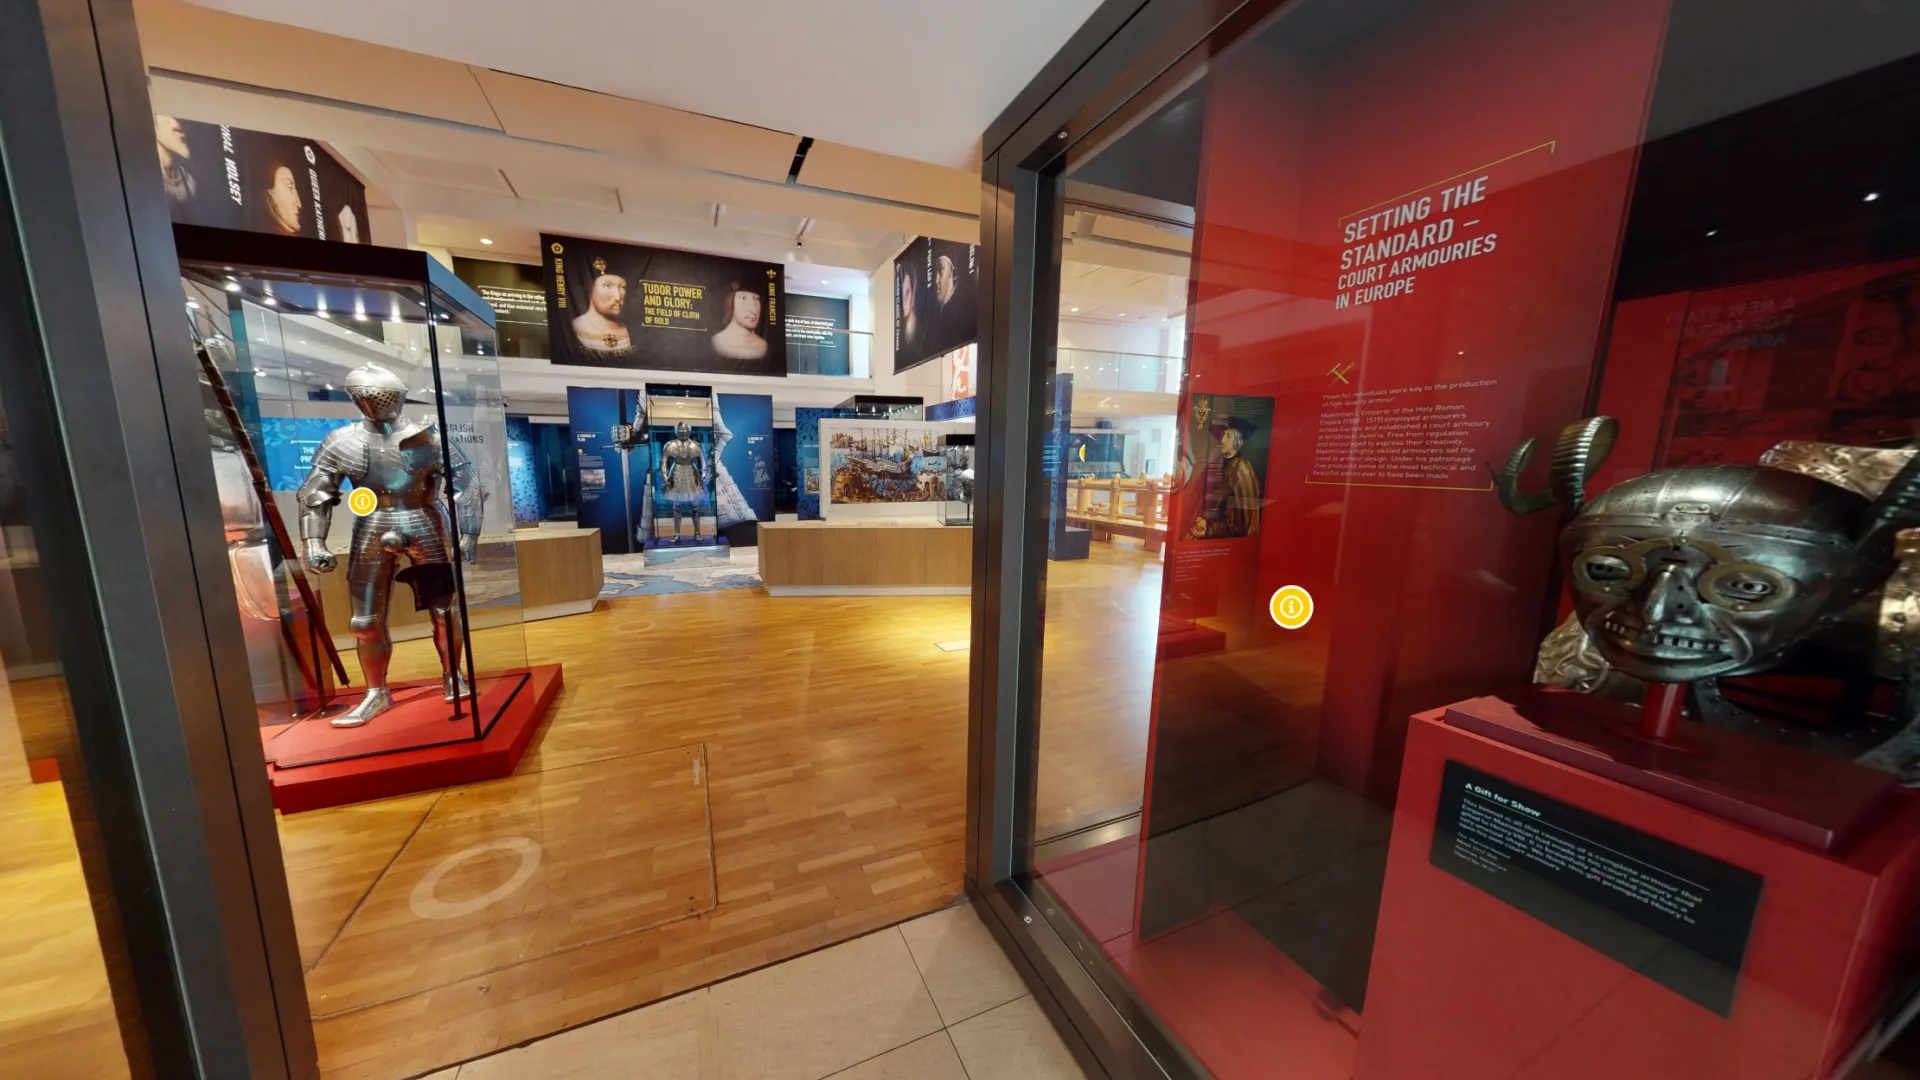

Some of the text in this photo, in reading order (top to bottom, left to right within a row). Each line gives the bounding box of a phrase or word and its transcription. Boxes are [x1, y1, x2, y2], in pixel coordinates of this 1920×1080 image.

[220, 124, 242, 206] INAL WOLSEY
[308, 168, 320, 201] QUEEN
[1344, 175, 1489, 244] SETTING THE
[1341, 218, 1454, 270] STANDARD
[554, 258, 564, 274] KING
[1338, 233, 1498, 290] COURT ARMOURIES
[556, 274, 566, 296] HENRY
[642, 283, 703, 299] TUDOR POWER
[768, 282, 776, 297] KING
[1335, 276, 1416, 310] IN EUROPE
[644, 295, 693, 309] AND GLORY:
[644, 307, 700, 319] THE FIELD OF CLOTH
[645, 316, 670, 325] OF GOLD
[1449, 379, 1498, 390] production
[1361, 409, 1391, 417] Emperor
[1415, 405, 1433, 414] Holy
[1435, 404, 1465, 412] Roman
[1384, 415, 1420, 424] employed
[1422, 412, 1467, 421] armourers
[446, 423, 474, 433] GLISH
[1378, 422, 1421, 431] established
[1452, 420, 1491, 429] armoury
[1426, 429, 1469, 438] regulation
[1429, 456, 1472, 464] patronage
[1474, 786, 1492, 798] Gift
[1494, 793, 1510, 804] for
[1510, 800, 1541, 817] Show
